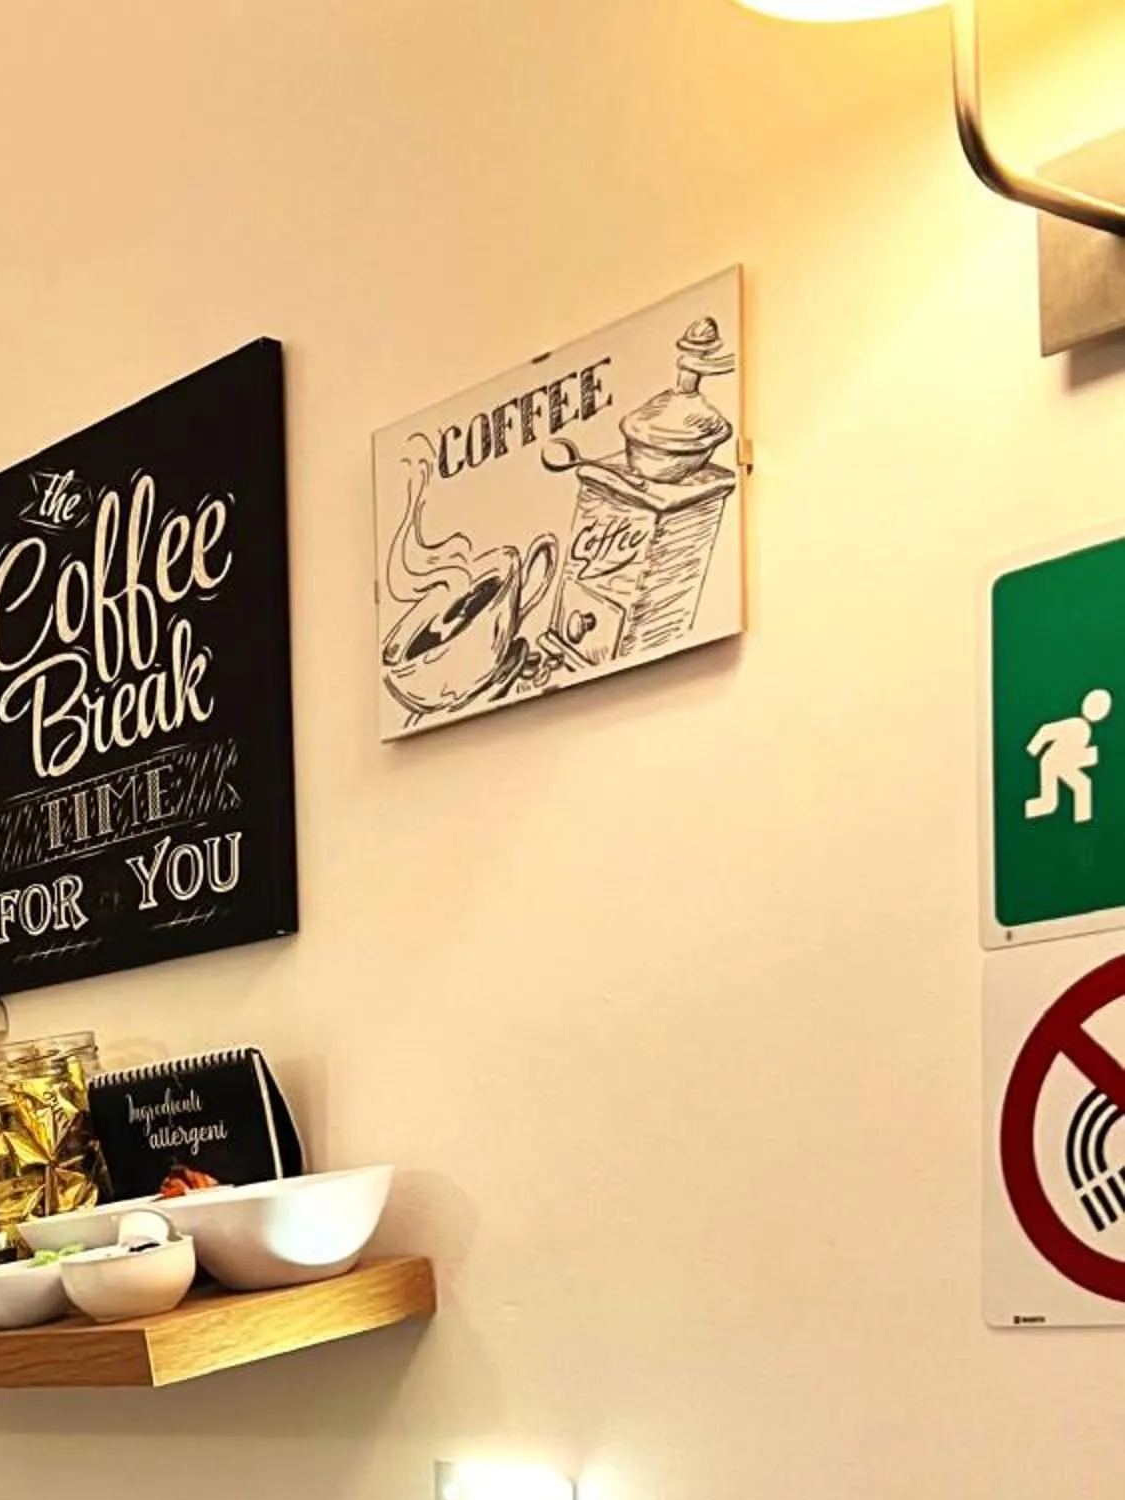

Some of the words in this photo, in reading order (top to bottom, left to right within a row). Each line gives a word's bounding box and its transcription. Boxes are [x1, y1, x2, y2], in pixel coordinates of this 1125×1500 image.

[437, 356, 613, 480] COFFEE
[41, 764, 177, 850] TIME
[125, 831, 243, 910] YOU
[149, 1120, 229, 1155] allergeni
